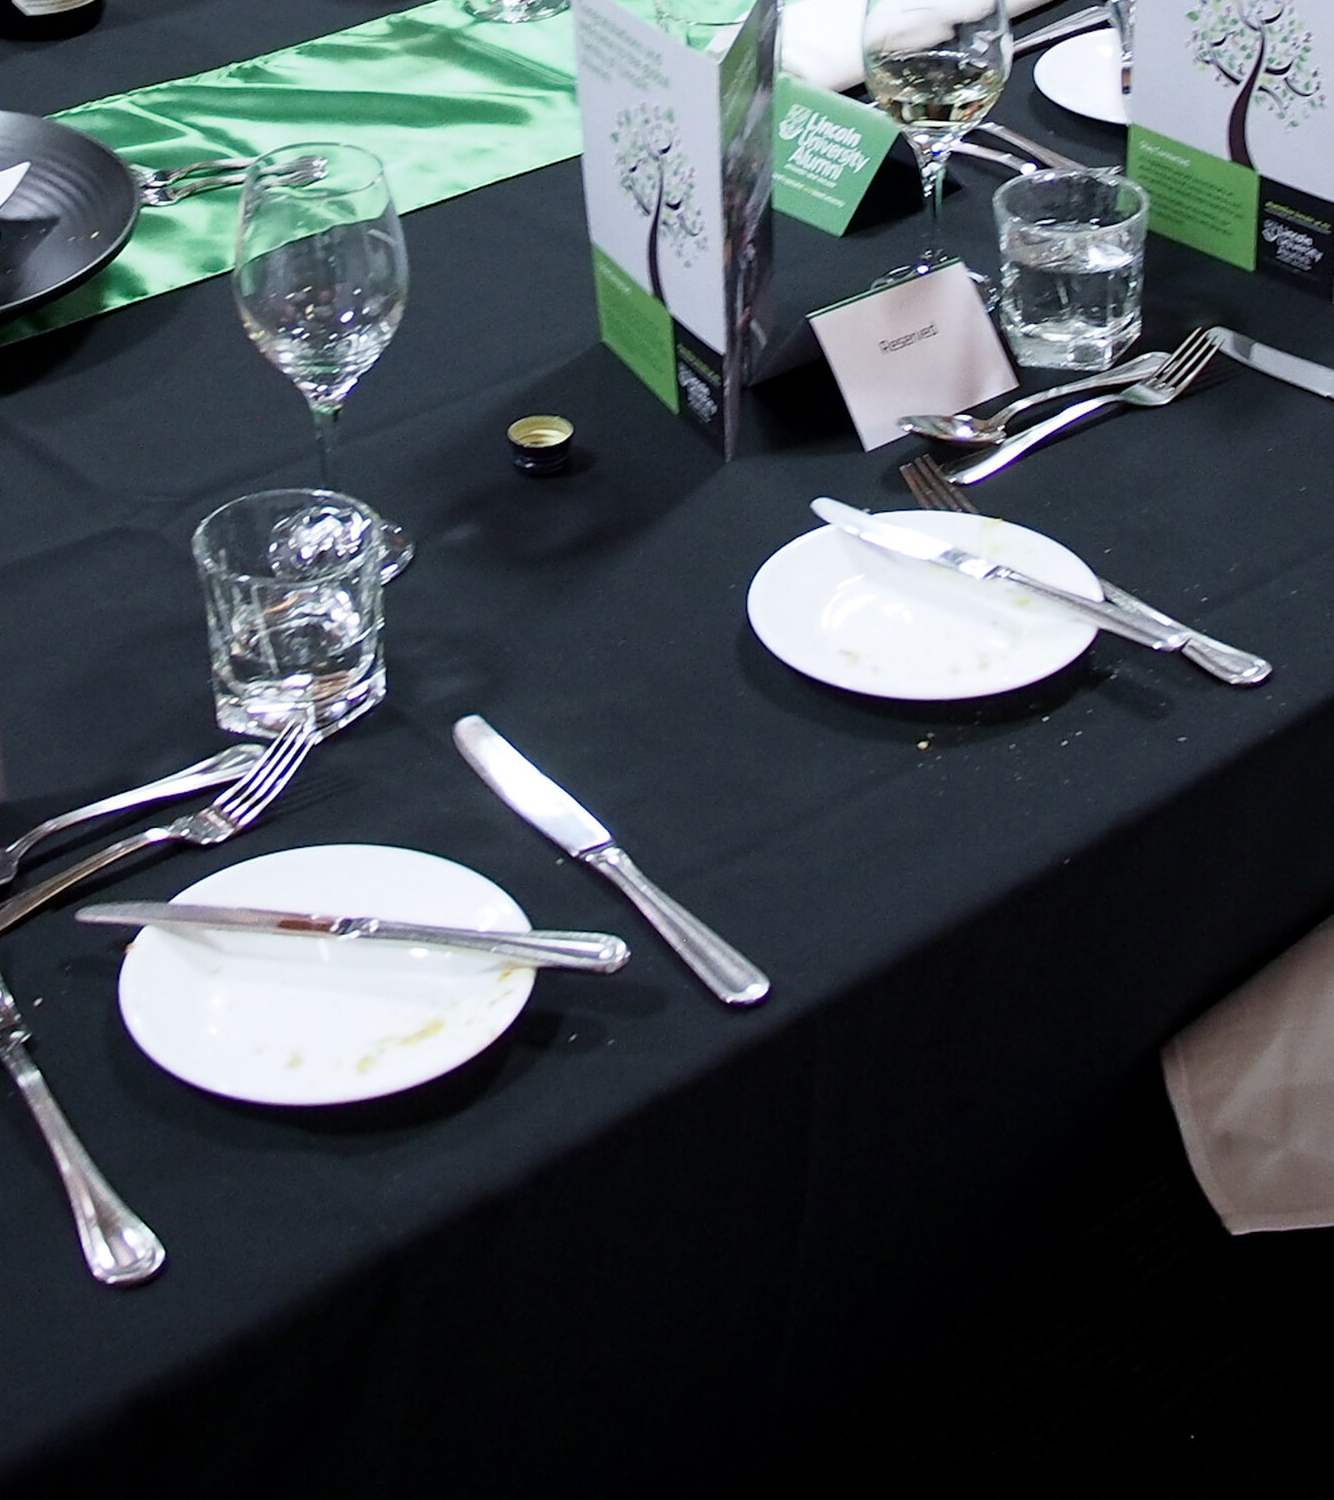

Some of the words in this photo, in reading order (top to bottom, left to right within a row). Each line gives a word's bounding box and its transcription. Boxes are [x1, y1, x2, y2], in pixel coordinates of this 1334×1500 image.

[805, 112, 862, 148] Lincoln
[788, 145, 844, 181] Alumni
[798, 129, 871, 174] University
[878, 324, 939, 355] Reserved
